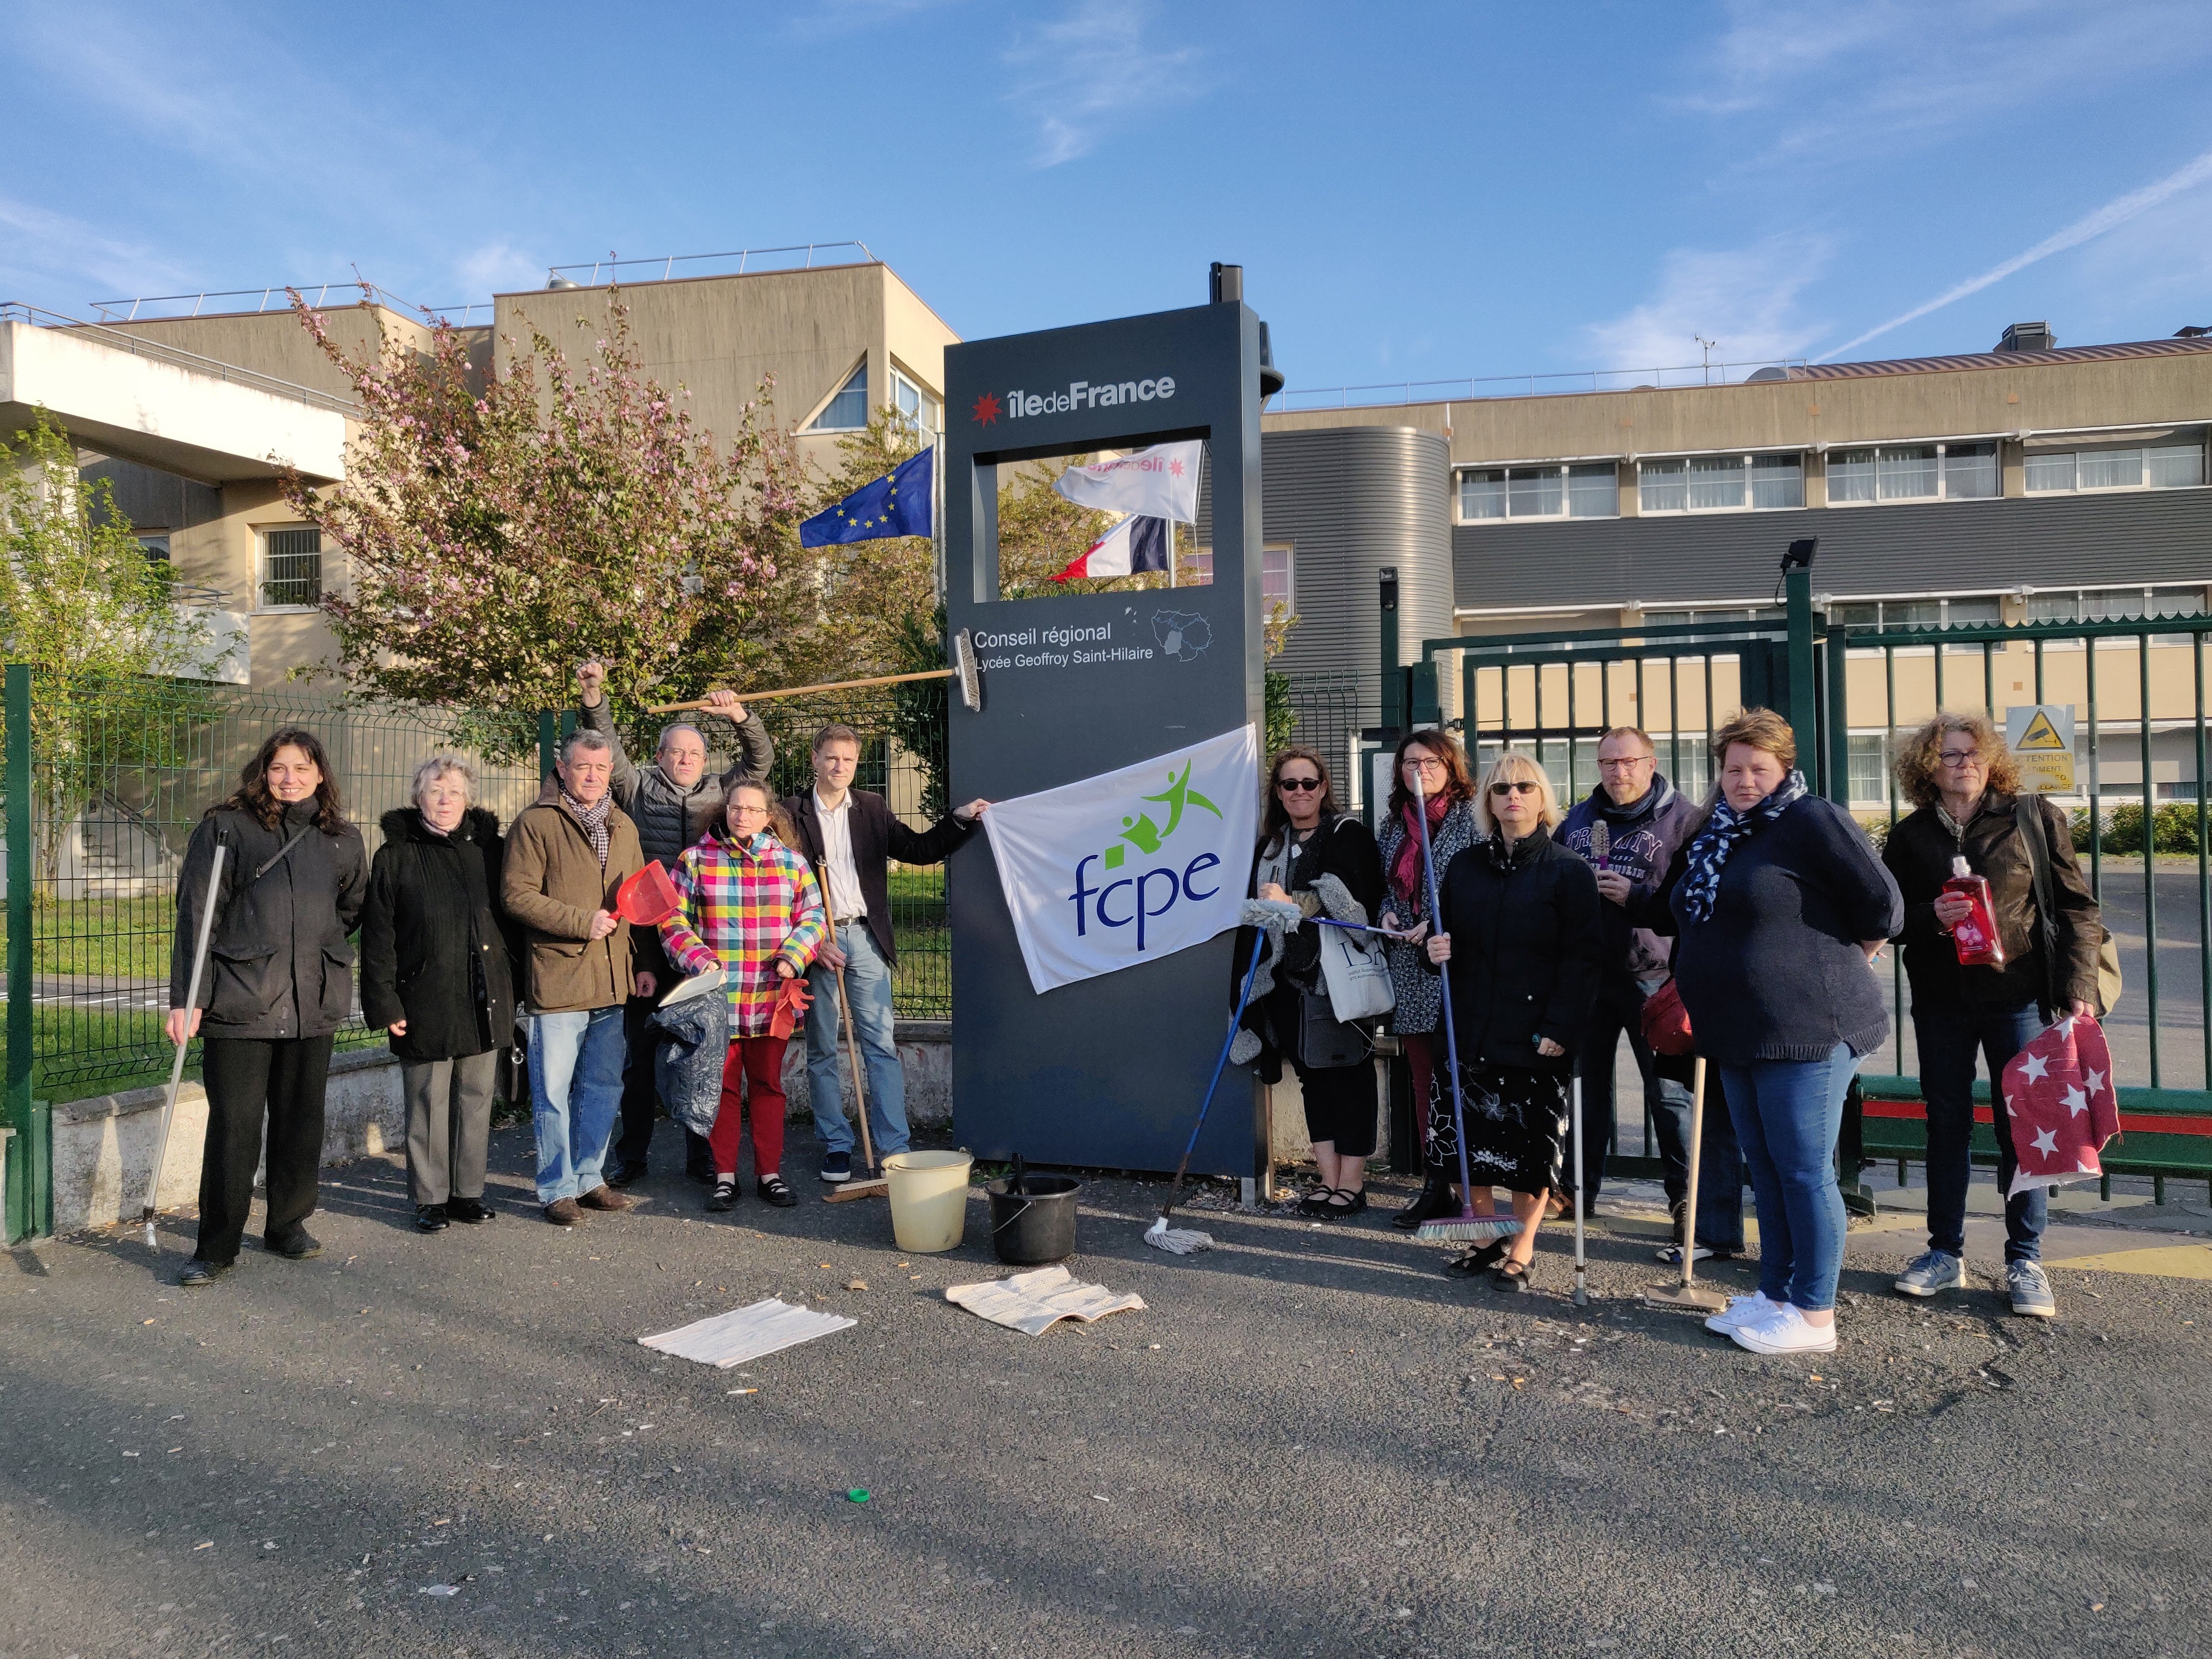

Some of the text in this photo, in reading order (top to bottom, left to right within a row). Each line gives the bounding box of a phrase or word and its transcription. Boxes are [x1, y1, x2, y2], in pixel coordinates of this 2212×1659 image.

[974, 623, 1111, 649] Conseil régional
[975, 646, 1153, 672] Lycée Geoffroy Saint-Hilaire
[1068, 853, 1221, 952] fcpe
